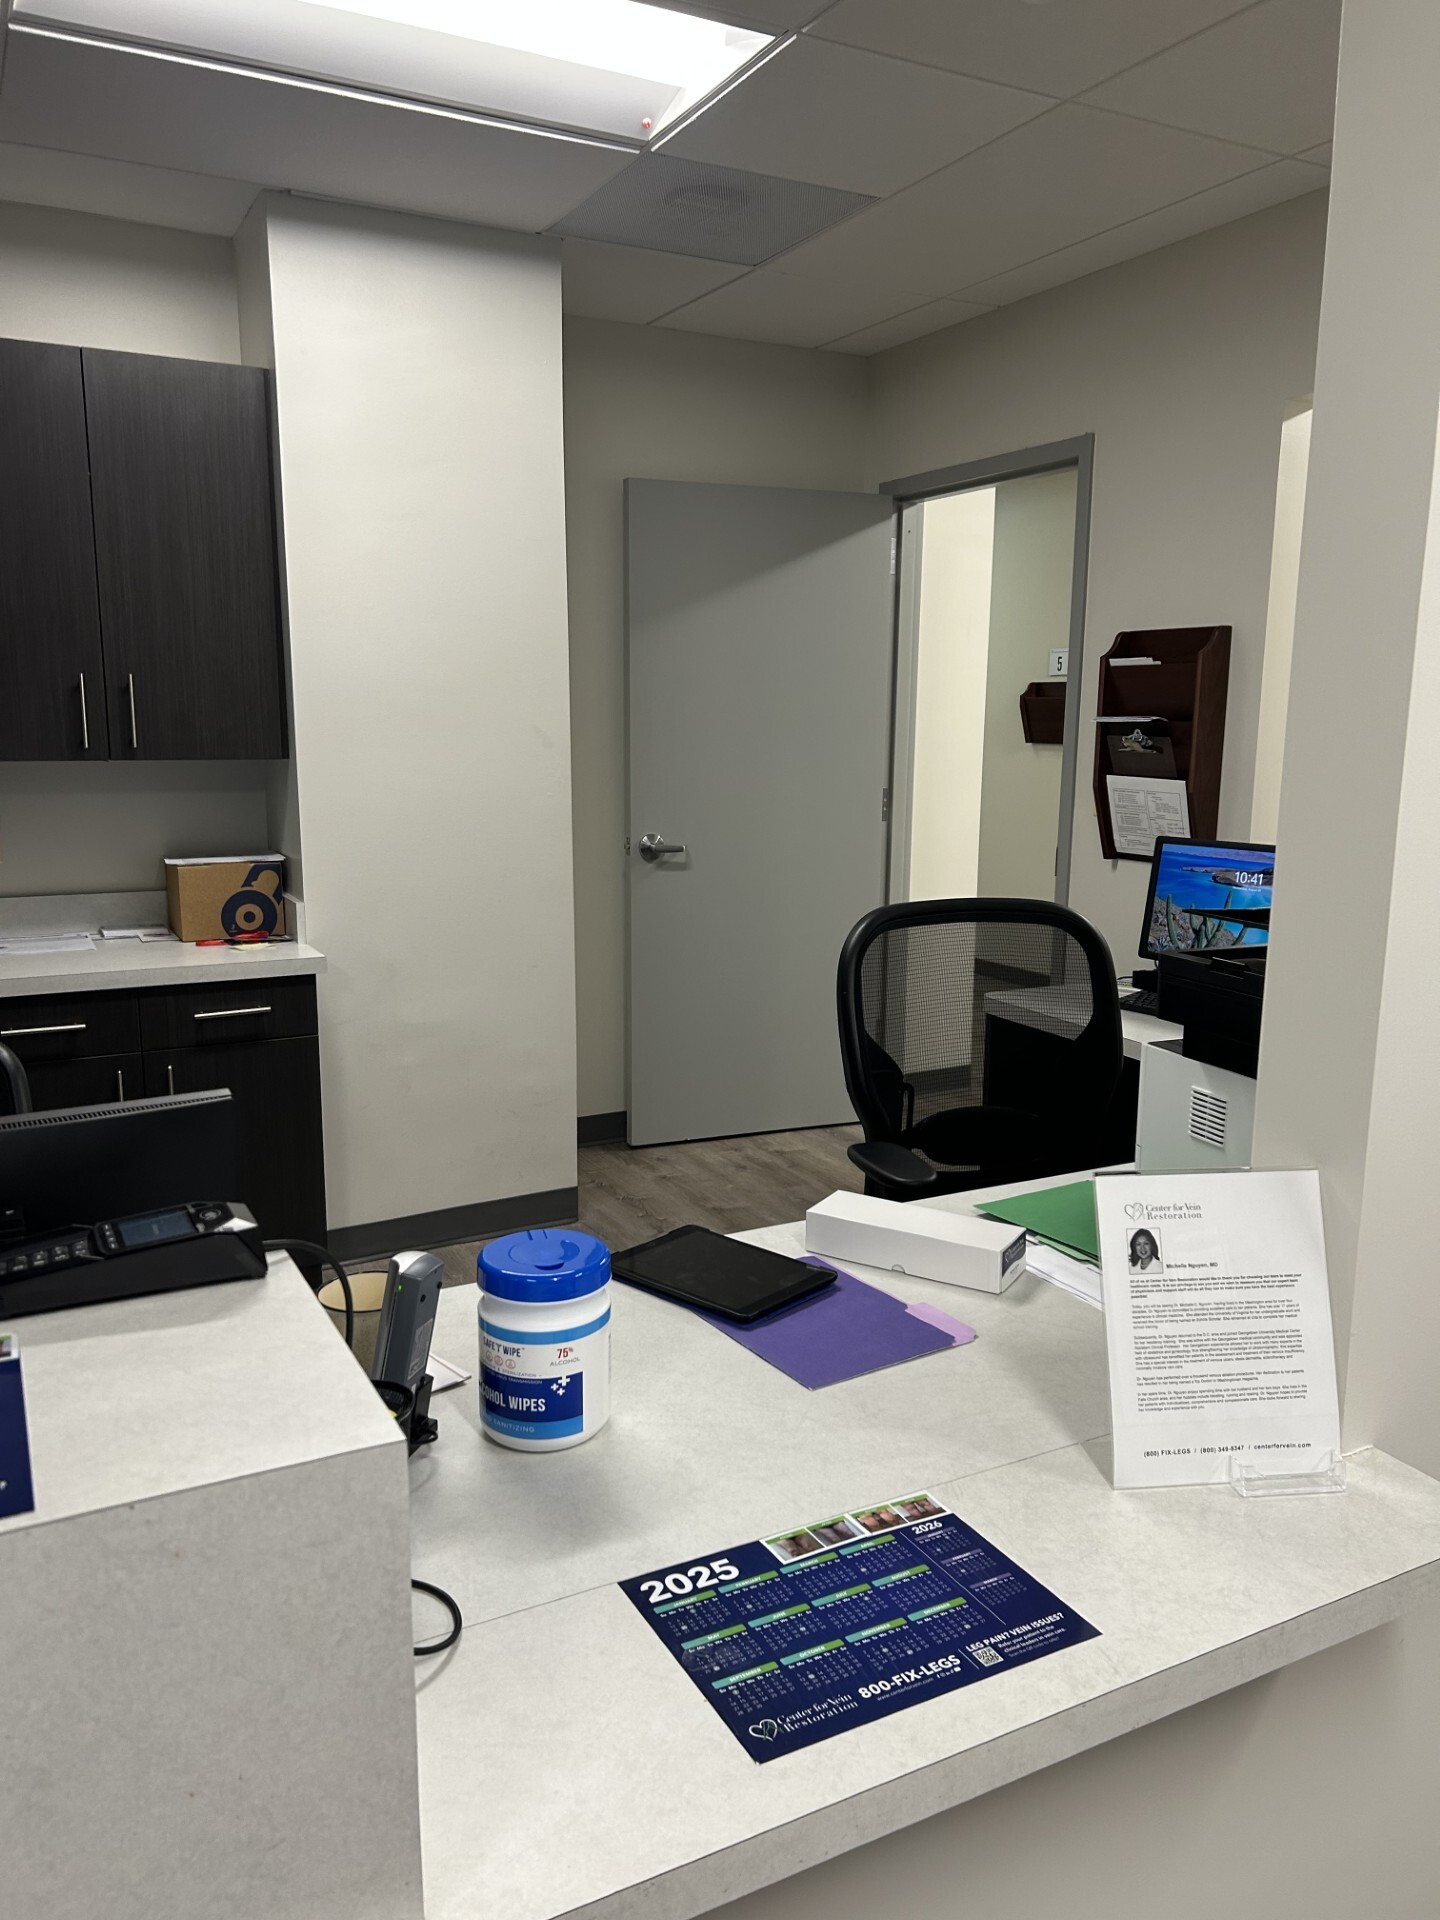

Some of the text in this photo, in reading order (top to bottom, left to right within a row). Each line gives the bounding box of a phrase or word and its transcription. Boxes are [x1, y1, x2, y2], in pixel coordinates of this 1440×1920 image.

[1056, 657, 1063, 672] 5
[1234, 872, 1264, 886] 10:41
[1184, 1202, 1201, 1210] Vein
[1146, 1212, 1202, 1220] Restoration
[550, 1356, 580, 1367] ALCOHOL
[480, 1382, 546, 1412] COHOL WIPES
[912, 1520, 942, 1534] 2026
[640, 1558, 740, 1604] 2025
[966, 1612, 1064, 1652] LEG PAIN? VEIN ISSUES?
[729, 1668, 762, 1682] SEPTEMBER
[858, 1654, 961, 1699] 800-FIX-LEGS
[777, 1692, 853, 1726] Center for Vein
[783, 1701, 859, 1733] Restoration
